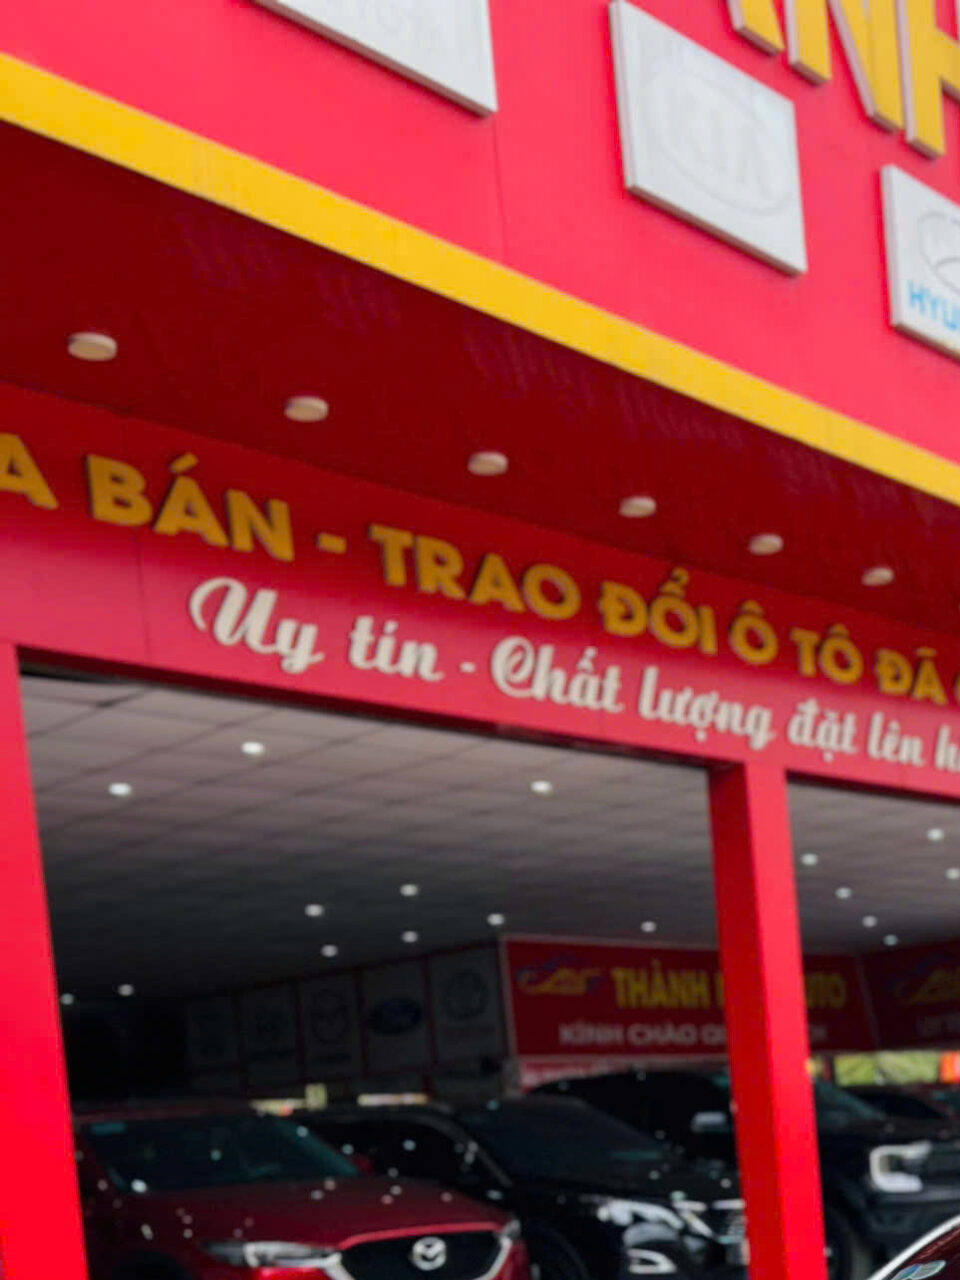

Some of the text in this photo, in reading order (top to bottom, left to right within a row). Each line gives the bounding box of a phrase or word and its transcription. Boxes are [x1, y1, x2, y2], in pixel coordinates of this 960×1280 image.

[86, 453, 295, 562] BÁN
[367, 523, 581, 620] TRAO
[597, 568, 717, 655] ĐỔI
[729, 600, 778, 664] Ô
[790, 624, 864, 684] TÔ
[874, 646, 946, 705] ĐÃ
[188, 576, 325, 674] Uy
[346, 613, 444, 683] tín
[490, 635, 624, 716] Chất
[637, 665, 776, 751] lượng
[788, 698, 860, 762] đặt
[866, 711, 926, 768] lên
